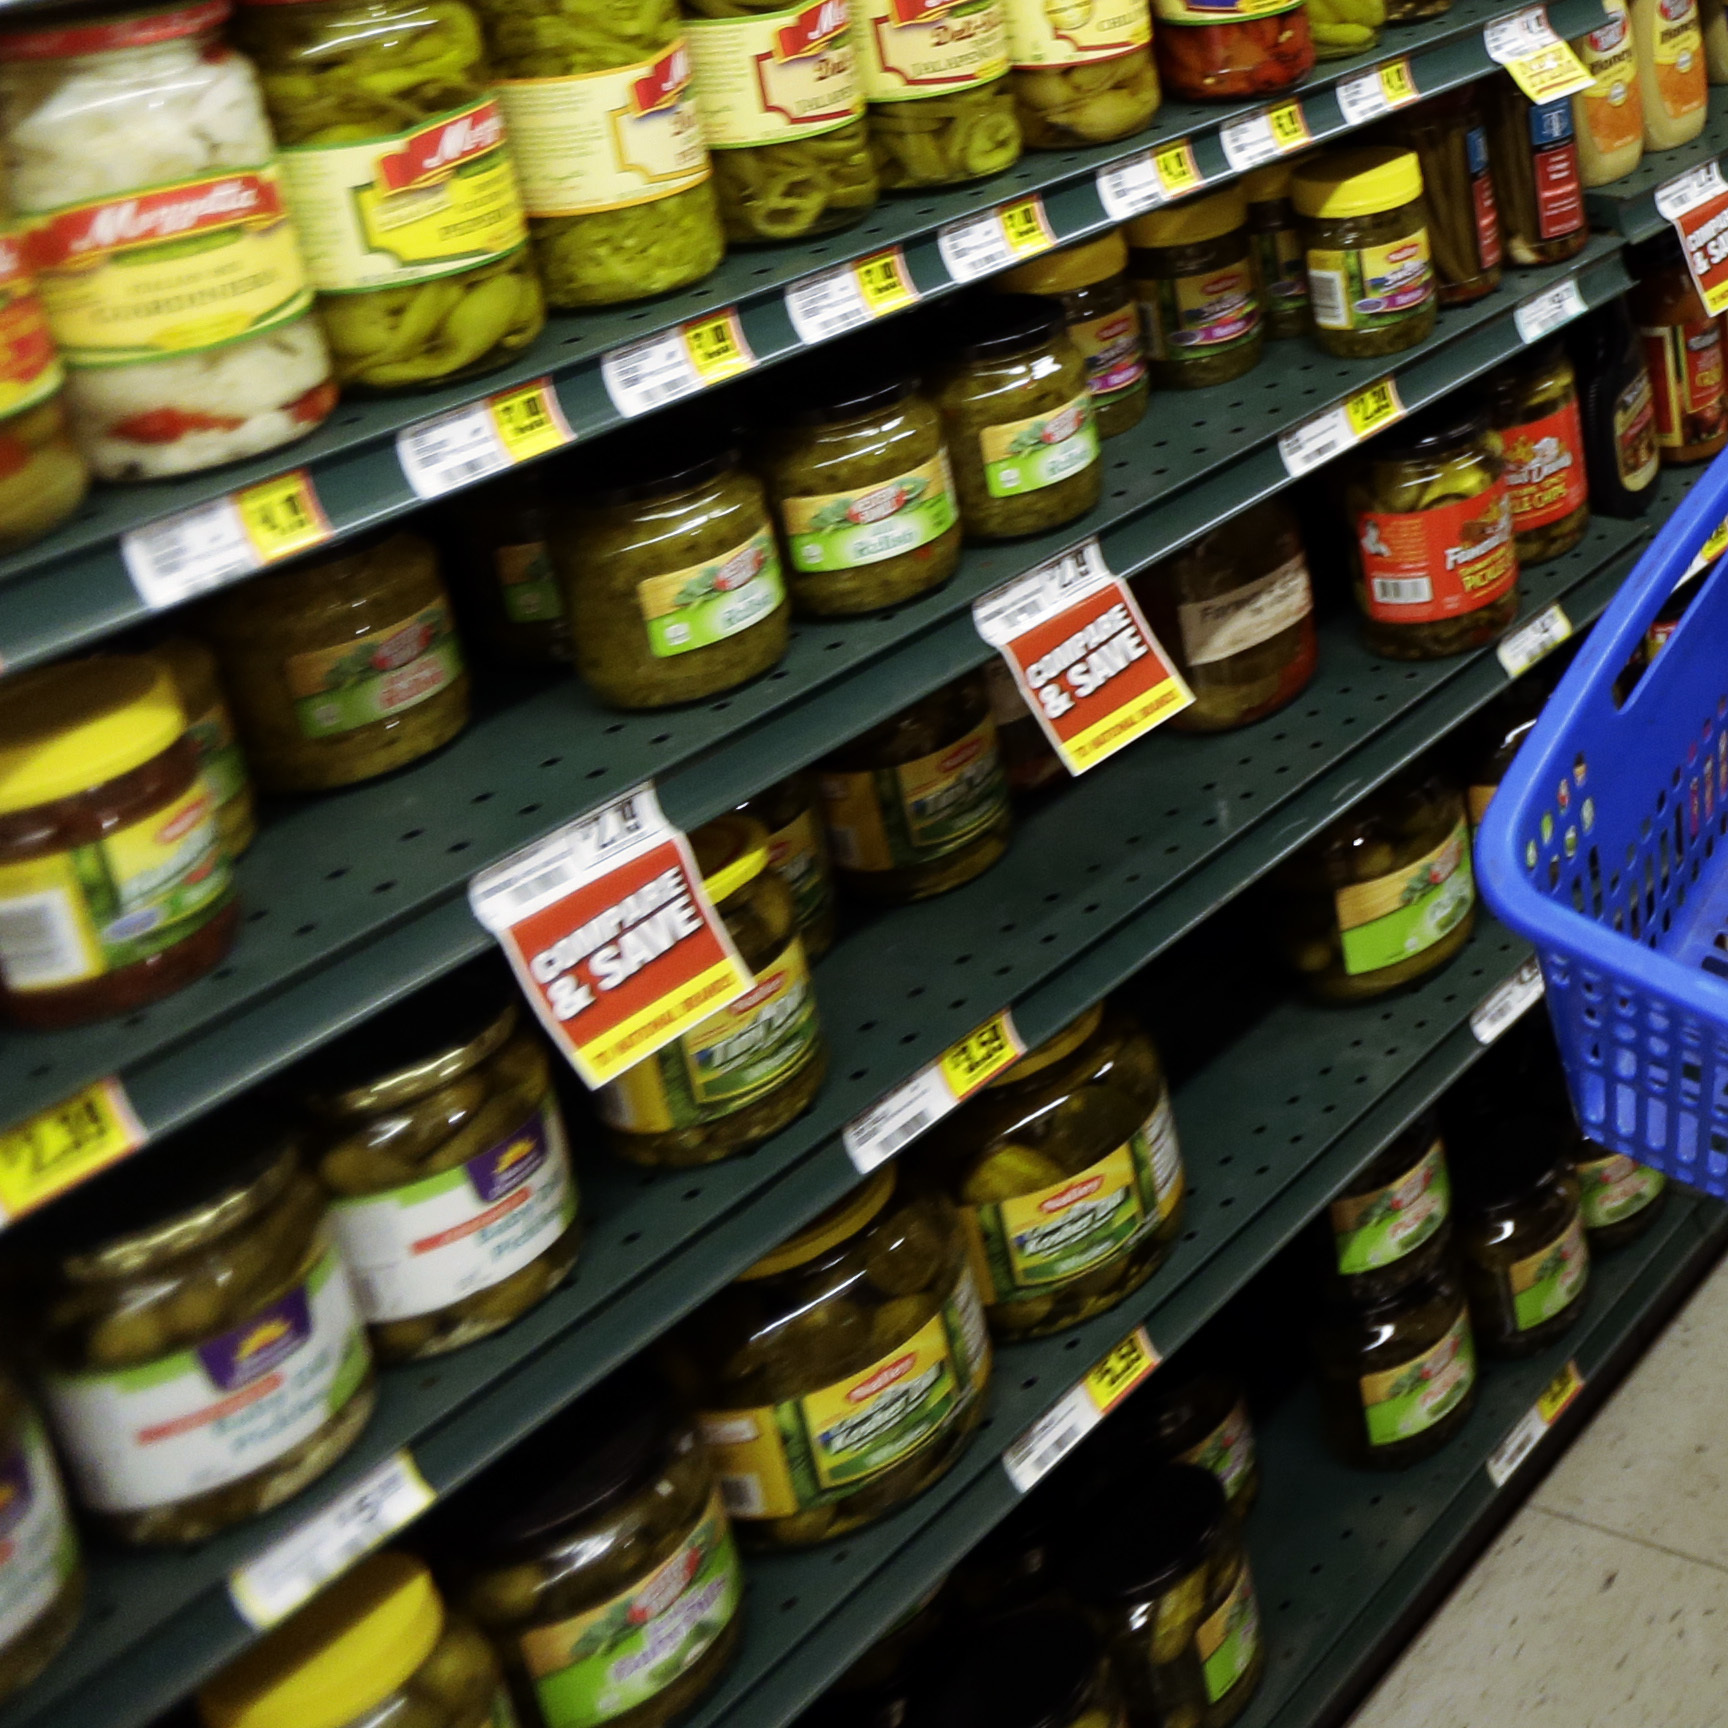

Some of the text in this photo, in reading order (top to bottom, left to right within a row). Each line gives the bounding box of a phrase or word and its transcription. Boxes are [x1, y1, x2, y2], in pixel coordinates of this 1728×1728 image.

[1025, 600, 1131, 692] COMPARE
[1039, 627, 1148, 720] & SAVE
[530, 863, 689, 984] COMPARE
[545, 891, 705, 1022] & SAVE
